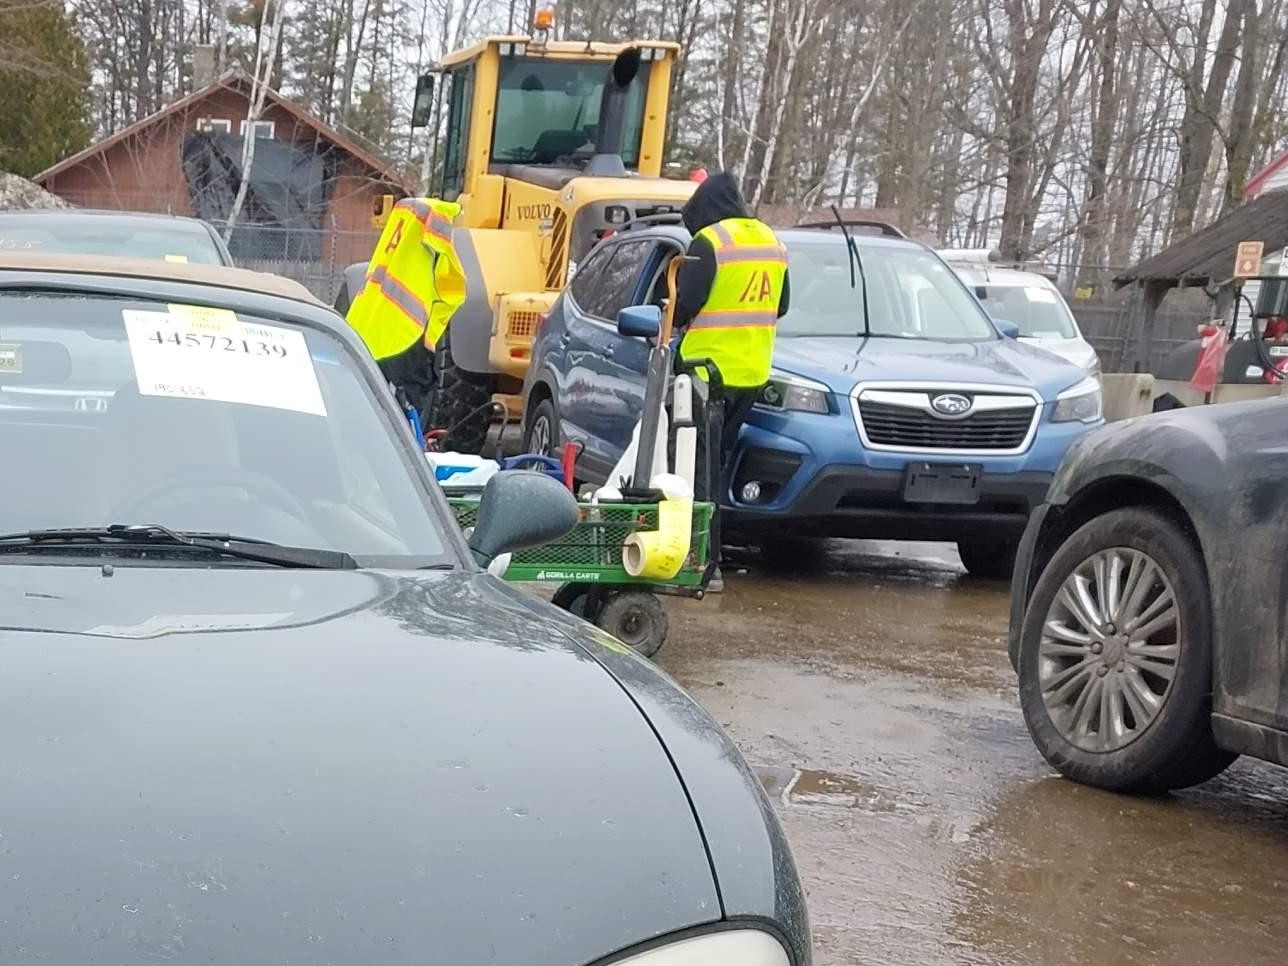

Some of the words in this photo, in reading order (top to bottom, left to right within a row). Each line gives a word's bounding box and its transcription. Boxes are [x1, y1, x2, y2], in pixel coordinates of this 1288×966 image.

[517, 203, 552, 220] VOLVO
[148, 330, 289, 358] 44572139
[545, 571, 575, 579] GORILLA
[575, 572, 601, 580] CARTS
